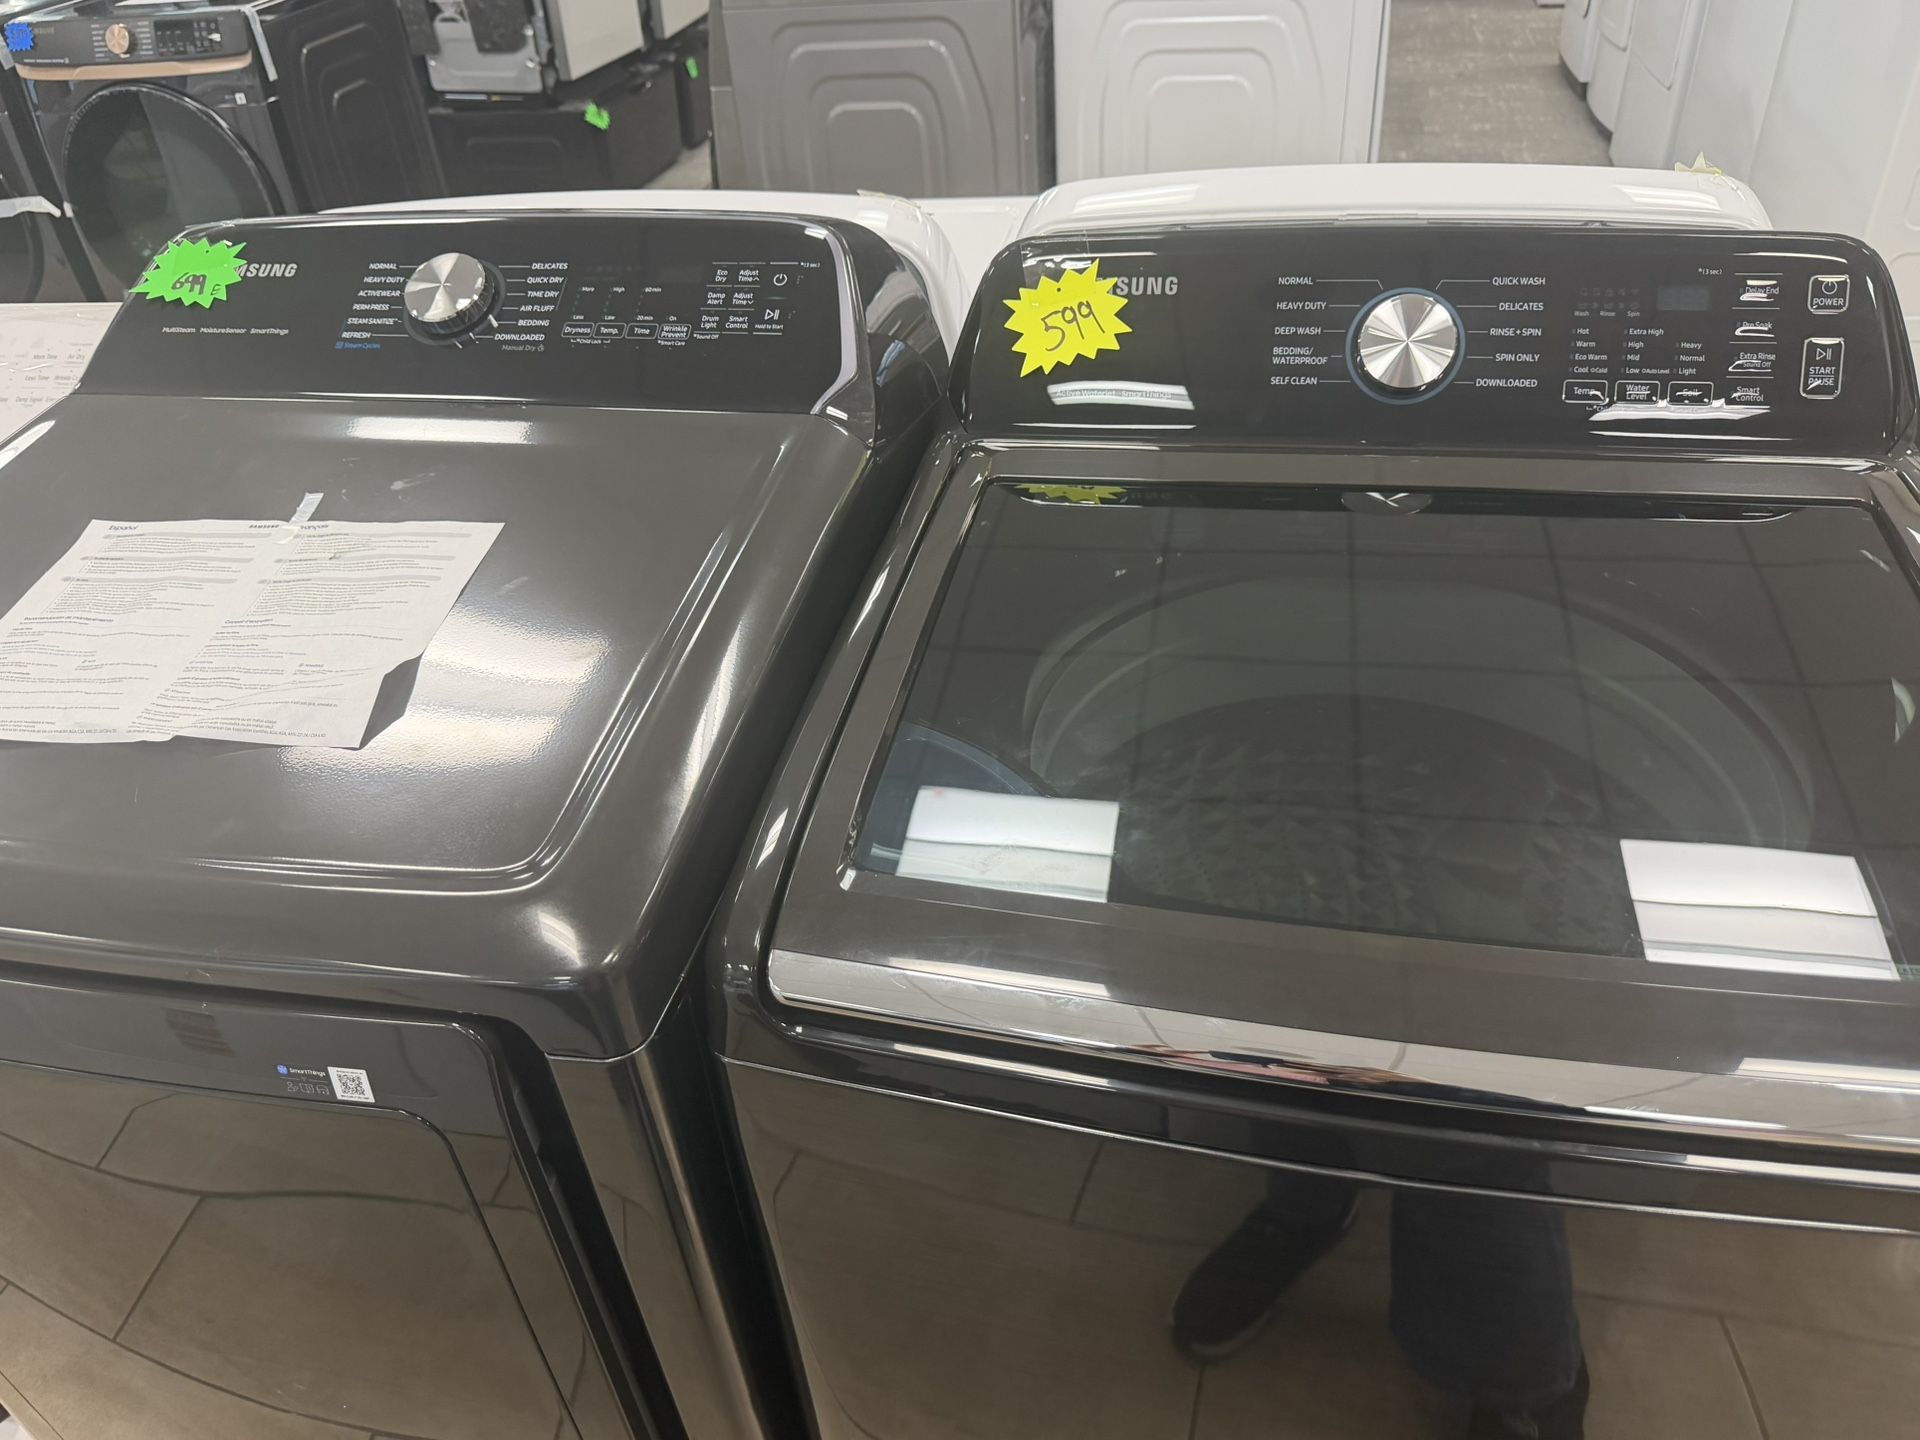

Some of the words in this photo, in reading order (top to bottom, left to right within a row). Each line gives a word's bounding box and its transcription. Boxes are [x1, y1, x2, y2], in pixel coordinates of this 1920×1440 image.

[171, 272, 207, 295] 699
[1278, 277, 1314, 285] NORMAL
[1492, 277, 1519, 286] QUICK
[1520, 277, 1546, 285] WASH
[1107, 276, 1179, 295] SUNG
[1745, 286, 1766, 294] Delay
[1766, 286, 1779, 294] End
[1276, 302, 1302, 310] HEAVY
[1304, 302, 1327, 310] DUTY
[1813, 298, 1844, 306] POWER
[1499, 302, 1544, 311] DELICATES
[1041, 300, 1105, 351] 599
[1755, 321, 1772, 329] Soak
[564, 326, 591, 334] Dryness
[1274, 327, 1296, 335] DEEP
[1296, 327, 1322, 335] WASH
[1490, 328, 1515, 336] RINSE
[1522, 328, 1542, 336] SPIN
[1648, 328, 1664, 336] High
[1628, 341, 1644, 349] High
[1680, 342, 1702, 350] Heavy
[1273, 347, 1314, 356] BEDDING/
[1495, 353, 1515, 362] SPIN
[1516, 354, 1540, 362] ONLY
[1739, 352, 1757, 360] Extra
[1757, 352, 1776, 360] Rinse
[1272, 357, 1328, 365] WATERPROOF
[1678, 367, 1697, 375] Light
[1808, 366, 1836, 375] START
[1270, 377, 1290, 385] SELF
[1290, 377, 1318, 385] CLEAN
[1475, 378, 1538, 387] DOWNLOADED
[1808, 377, 1835, 386] PAUSE
[1736, 394, 1764, 402] Control
[289, 1067, 326, 1077] SmartThings
